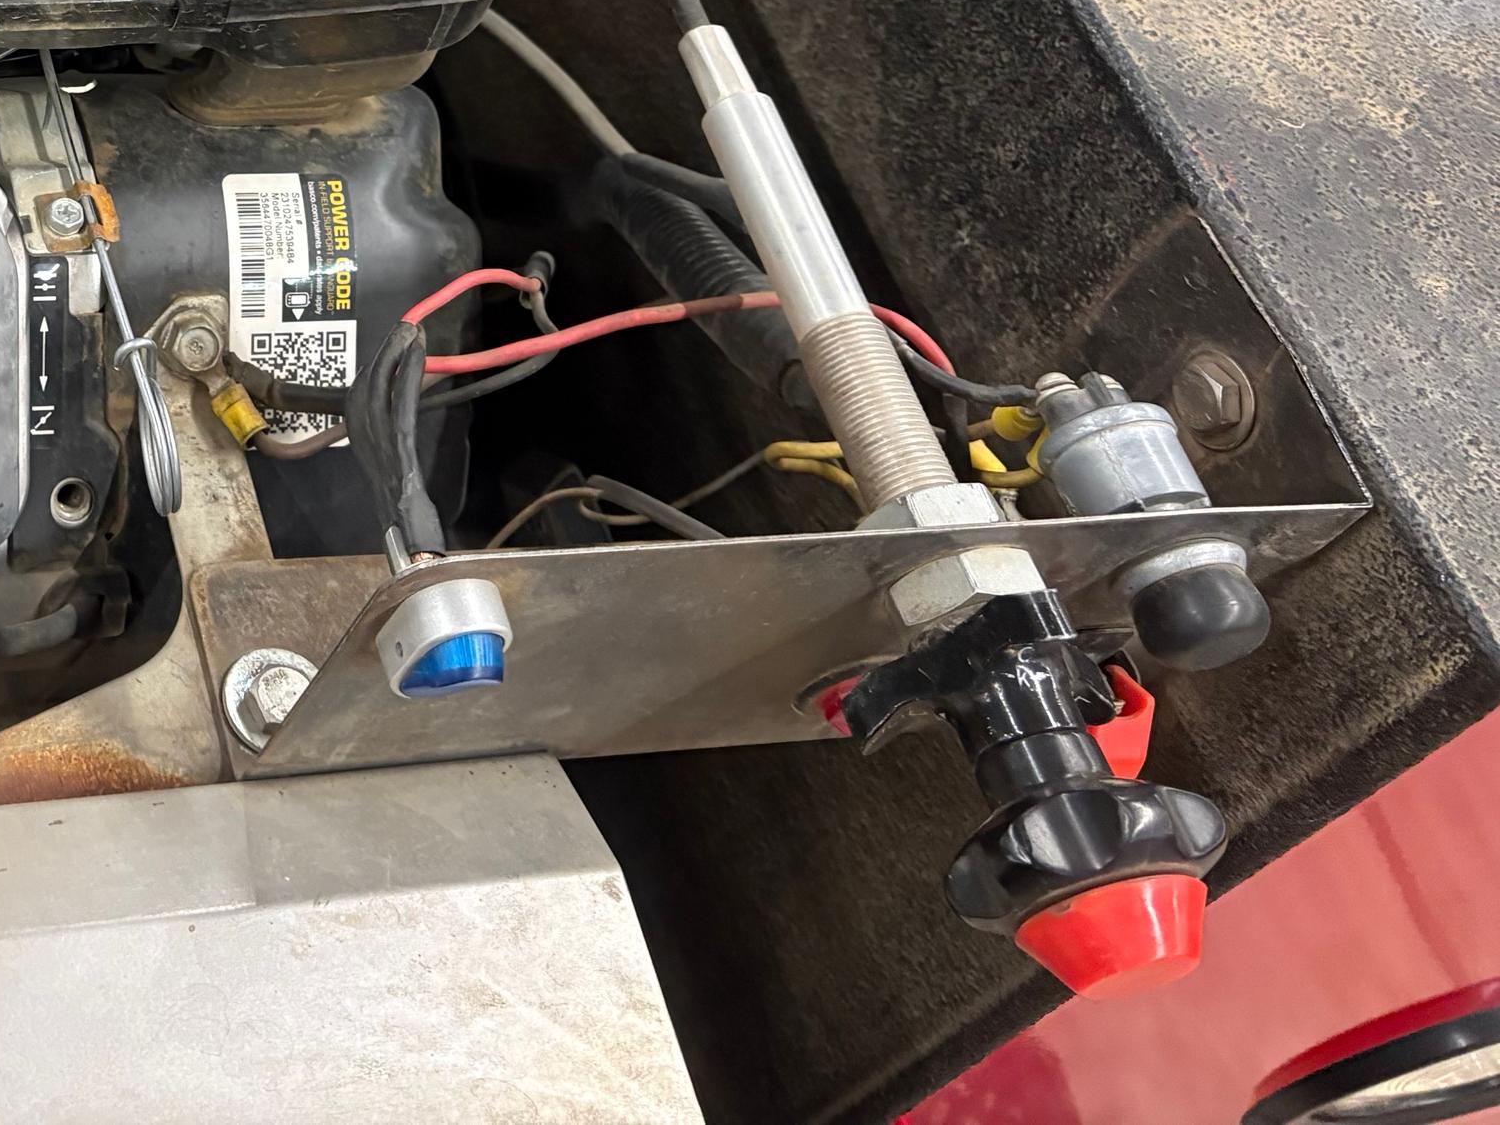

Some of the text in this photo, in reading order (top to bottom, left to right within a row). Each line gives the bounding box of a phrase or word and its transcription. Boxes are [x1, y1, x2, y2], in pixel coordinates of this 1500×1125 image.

[271, 192, 282, 220] Model
[291, 192, 302, 217] Serial
[307, 181, 322, 249] basco.com/patents
[318, 181, 330, 215] IN-FIELD
[322, 216, 334, 255] SUPPORT
[327, 180, 351, 310] POWER CODE
[314, 295, 323, 315] apply
